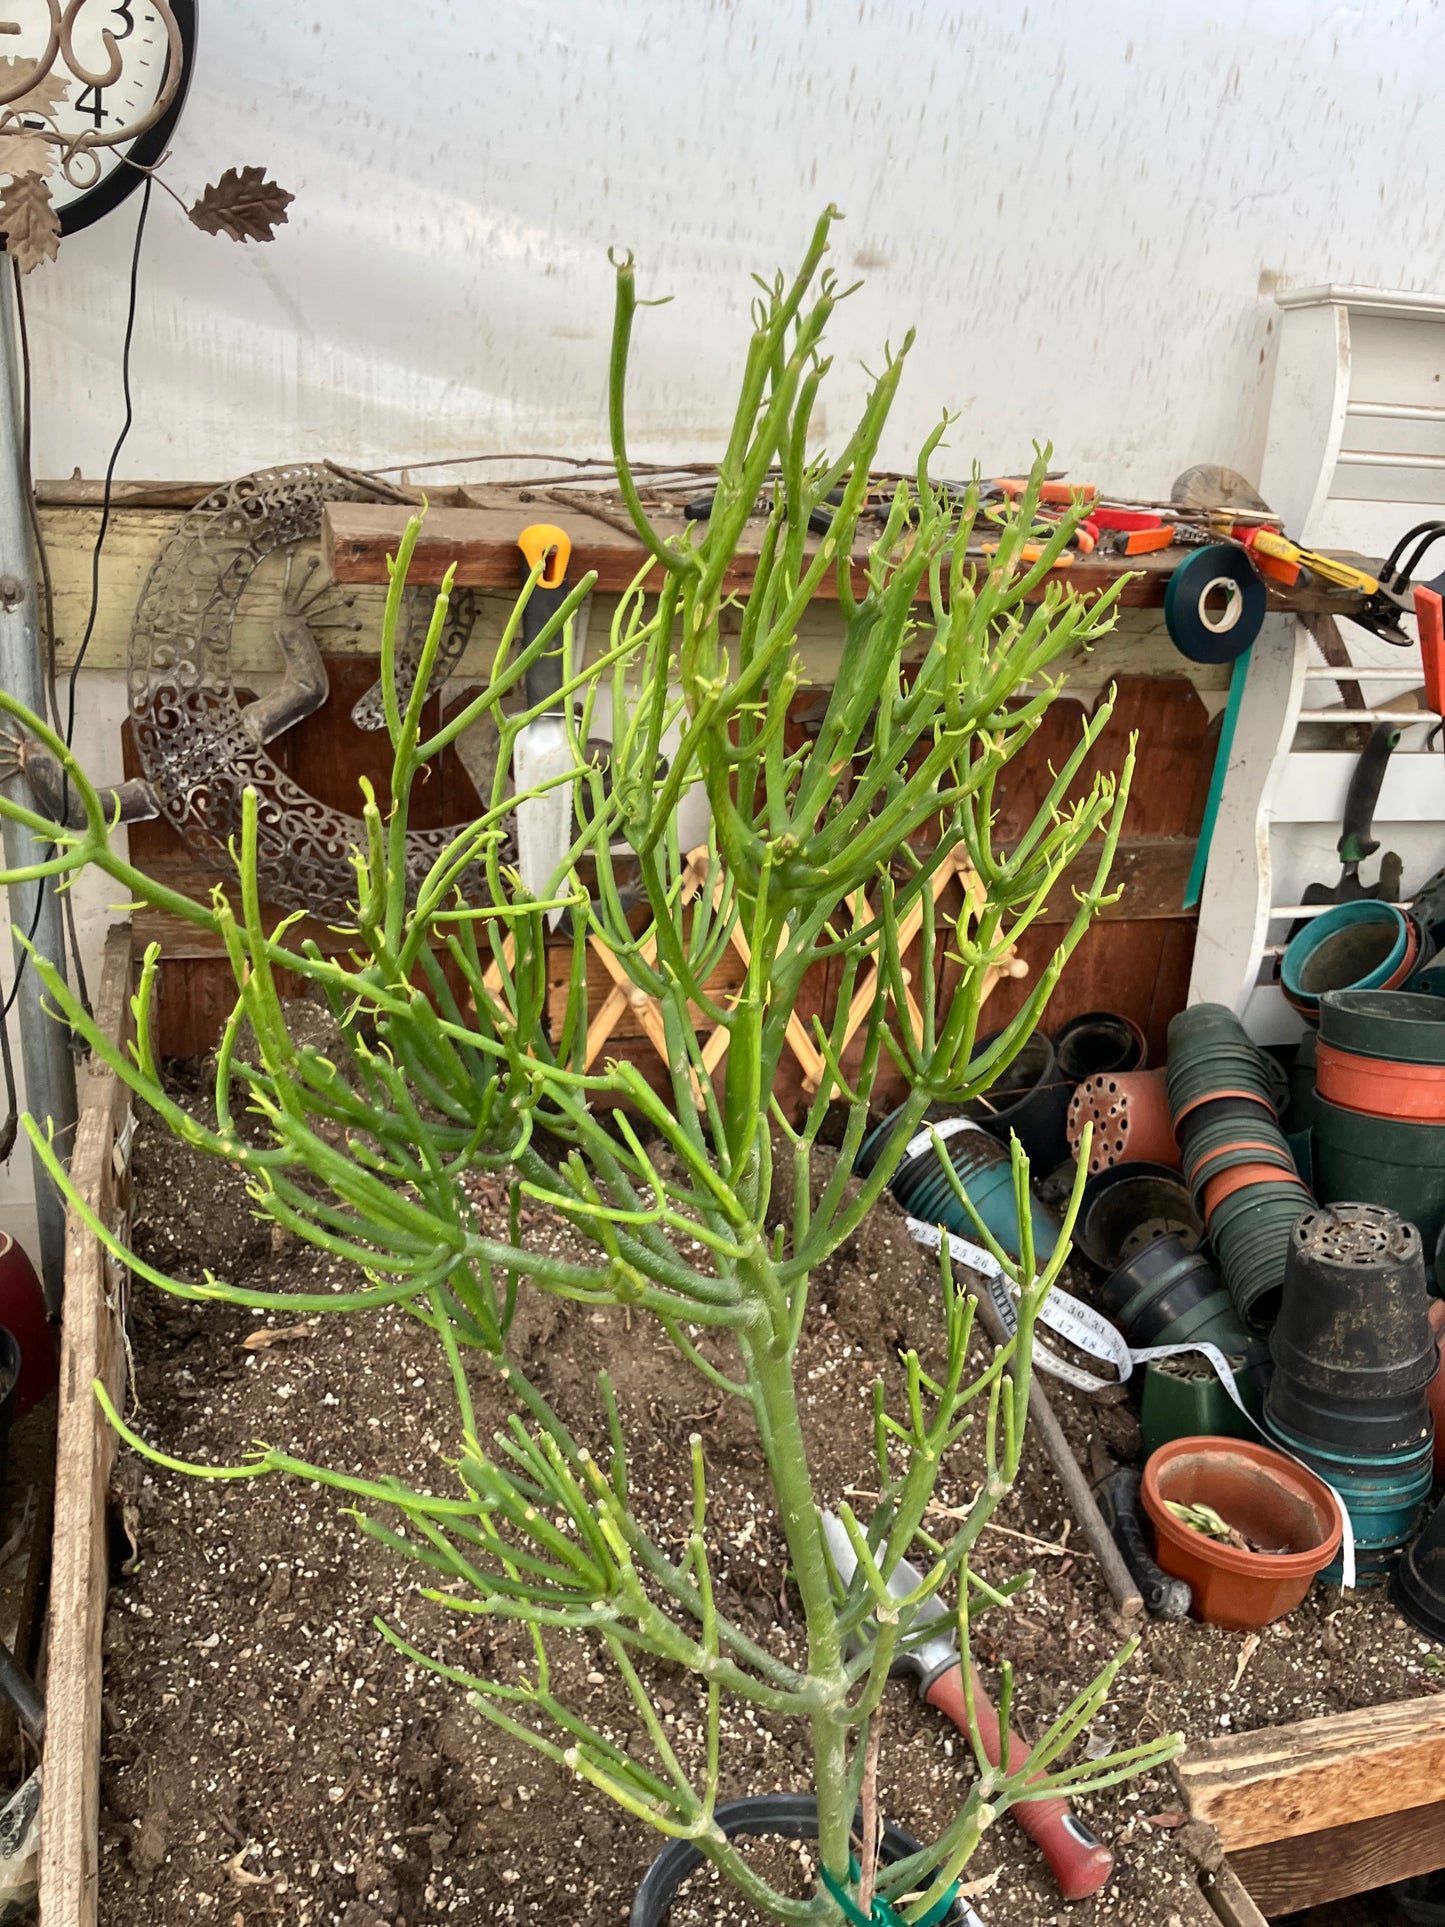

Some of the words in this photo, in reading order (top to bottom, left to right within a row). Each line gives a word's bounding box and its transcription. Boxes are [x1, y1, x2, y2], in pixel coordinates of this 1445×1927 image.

[75, 86, 109, 128] 4
[952, 1243, 968, 1258] 25
[973, 1254, 990, 1269] 26
[1056, 1320, 1074, 1333] 47
[1067, 1304, 1085, 1319] 30
[1091, 1320, 1105, 1334] 31
